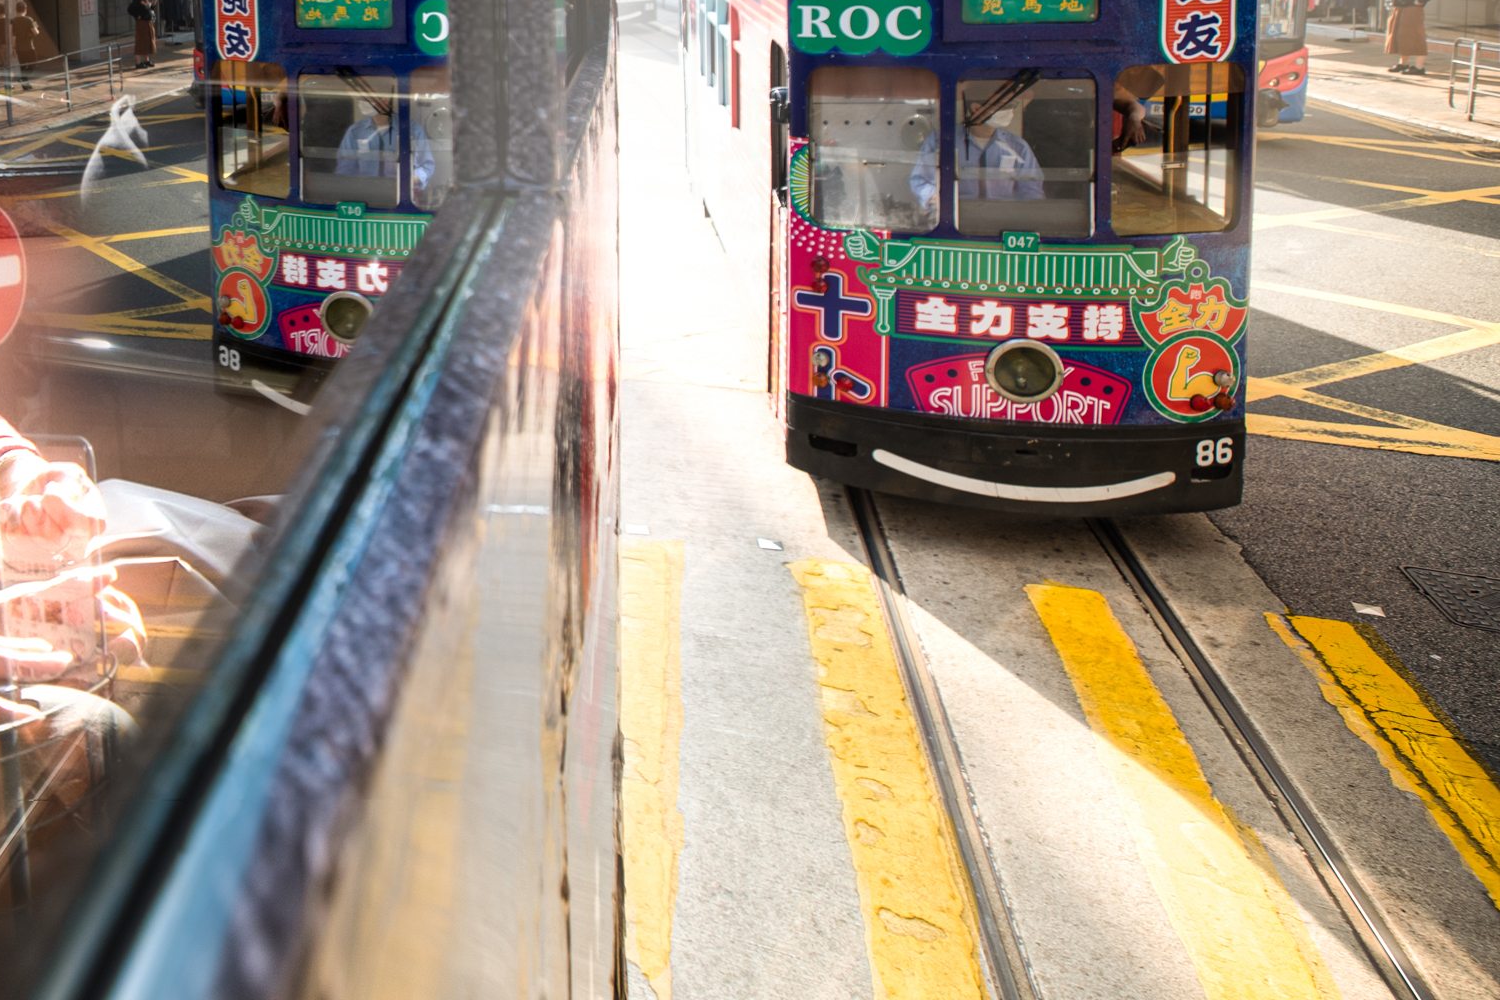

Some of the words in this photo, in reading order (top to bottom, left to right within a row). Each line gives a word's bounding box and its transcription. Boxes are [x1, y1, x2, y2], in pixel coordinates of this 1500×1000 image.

[796, 5, 923, 41] ROC
[1007, 235, 1035, 249] 047
[914, 297, 1124, 341] 全力支持
[1158, 296, 1230, 335] 全力
[1196, 438, 1233, 467] 86
